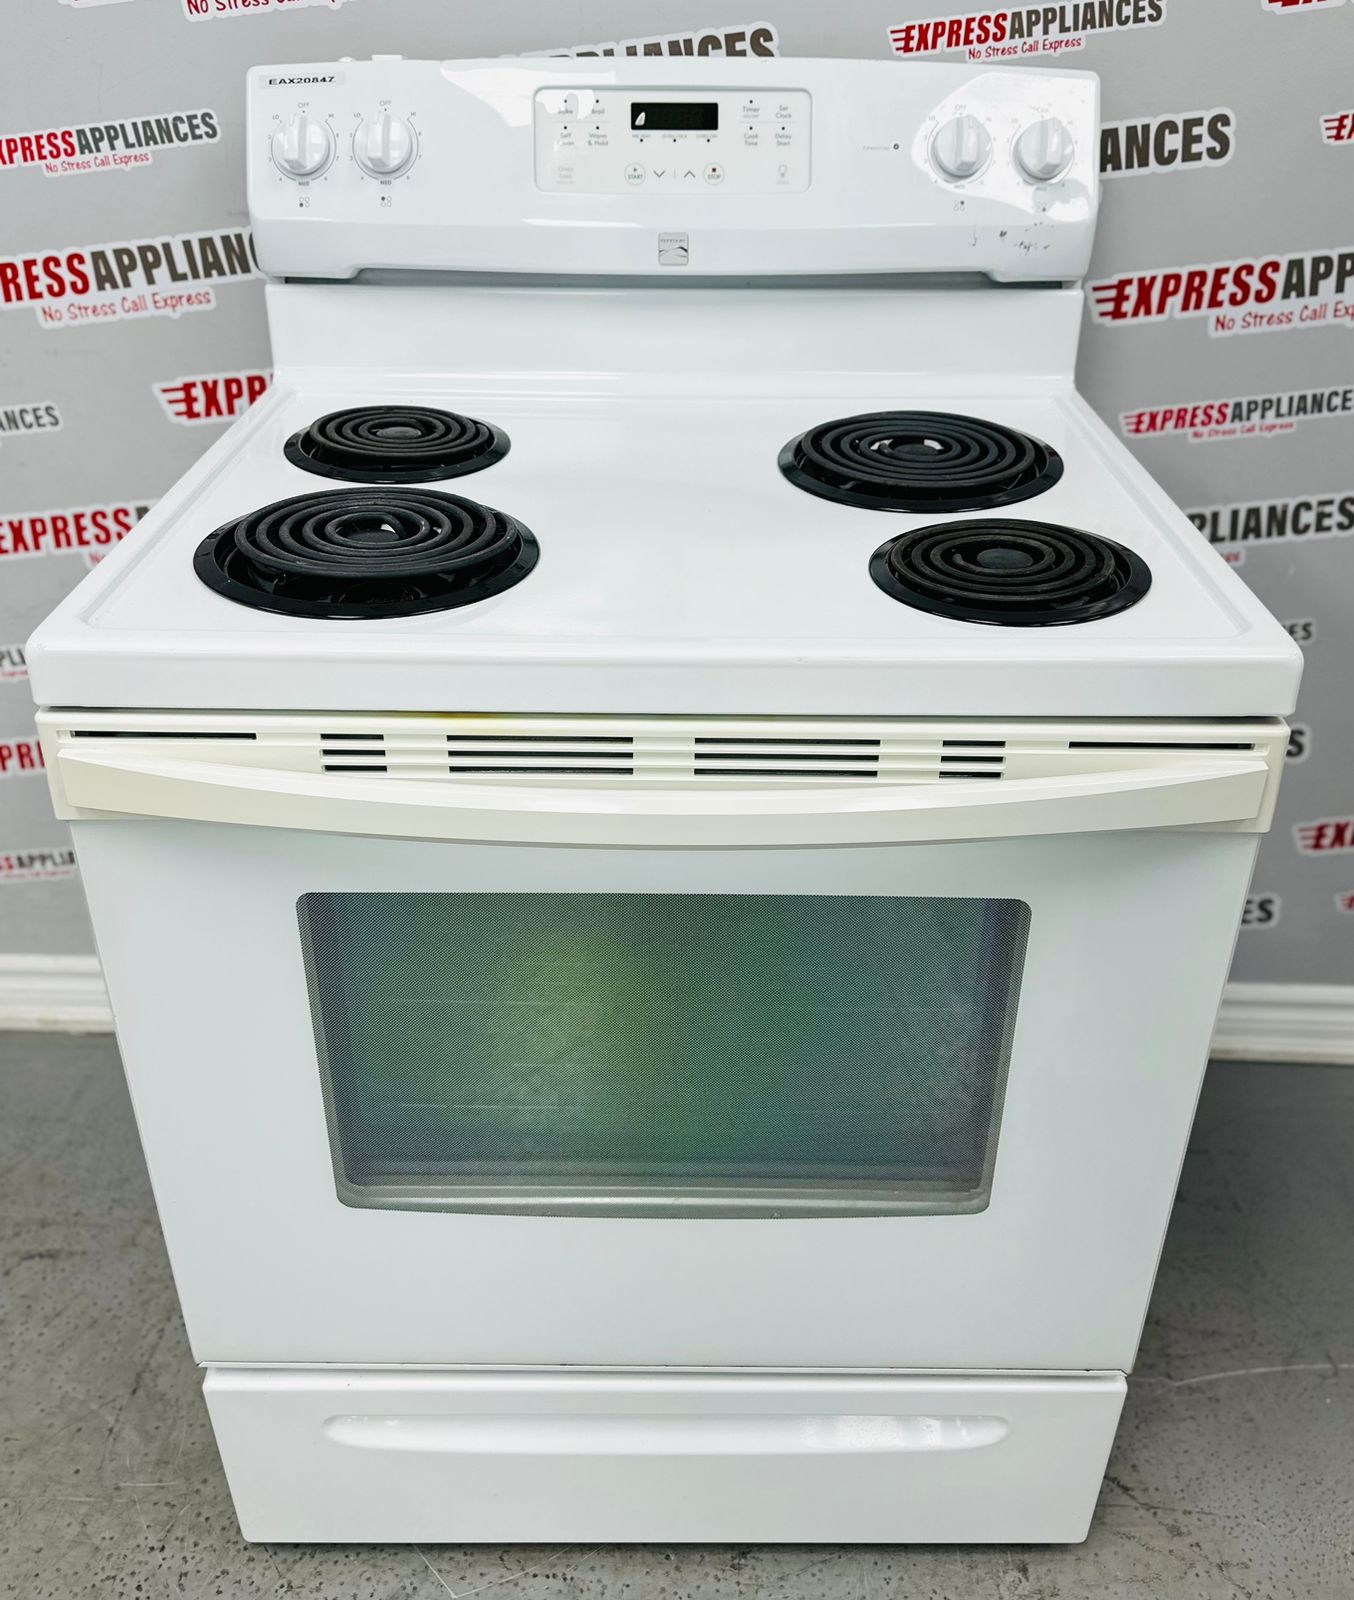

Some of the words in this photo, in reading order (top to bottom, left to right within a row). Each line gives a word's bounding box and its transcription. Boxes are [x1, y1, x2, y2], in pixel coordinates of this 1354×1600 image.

[968, 48, 982, 60] No
[986, 46, 1018, 58] Stress
[1022, 40, 1039, 53] Call
[1043, 37, 1082, 52] Express
[268, 76, 335, 86] EAX20847
[1099, 113, 1231, 173] ANCES
[45, 162, 59, 174] No
[61, 158, 92, 172] Stress
[94, 155, 111, 167] Call
[113, 152, 150, 165] Express
[0, 232, 260, 303] RESSAPPLIAN
[42, 305, 62, 322] No
[67, 302, 117, 320] Stress
[121, 296, 148, 313] Call
[152, 290, 212, 312] Express
[1215, 315, 1235, 332] No
[1241, 310, 1293, 329] Stress
[1300, 303, 1328, 322] Call
